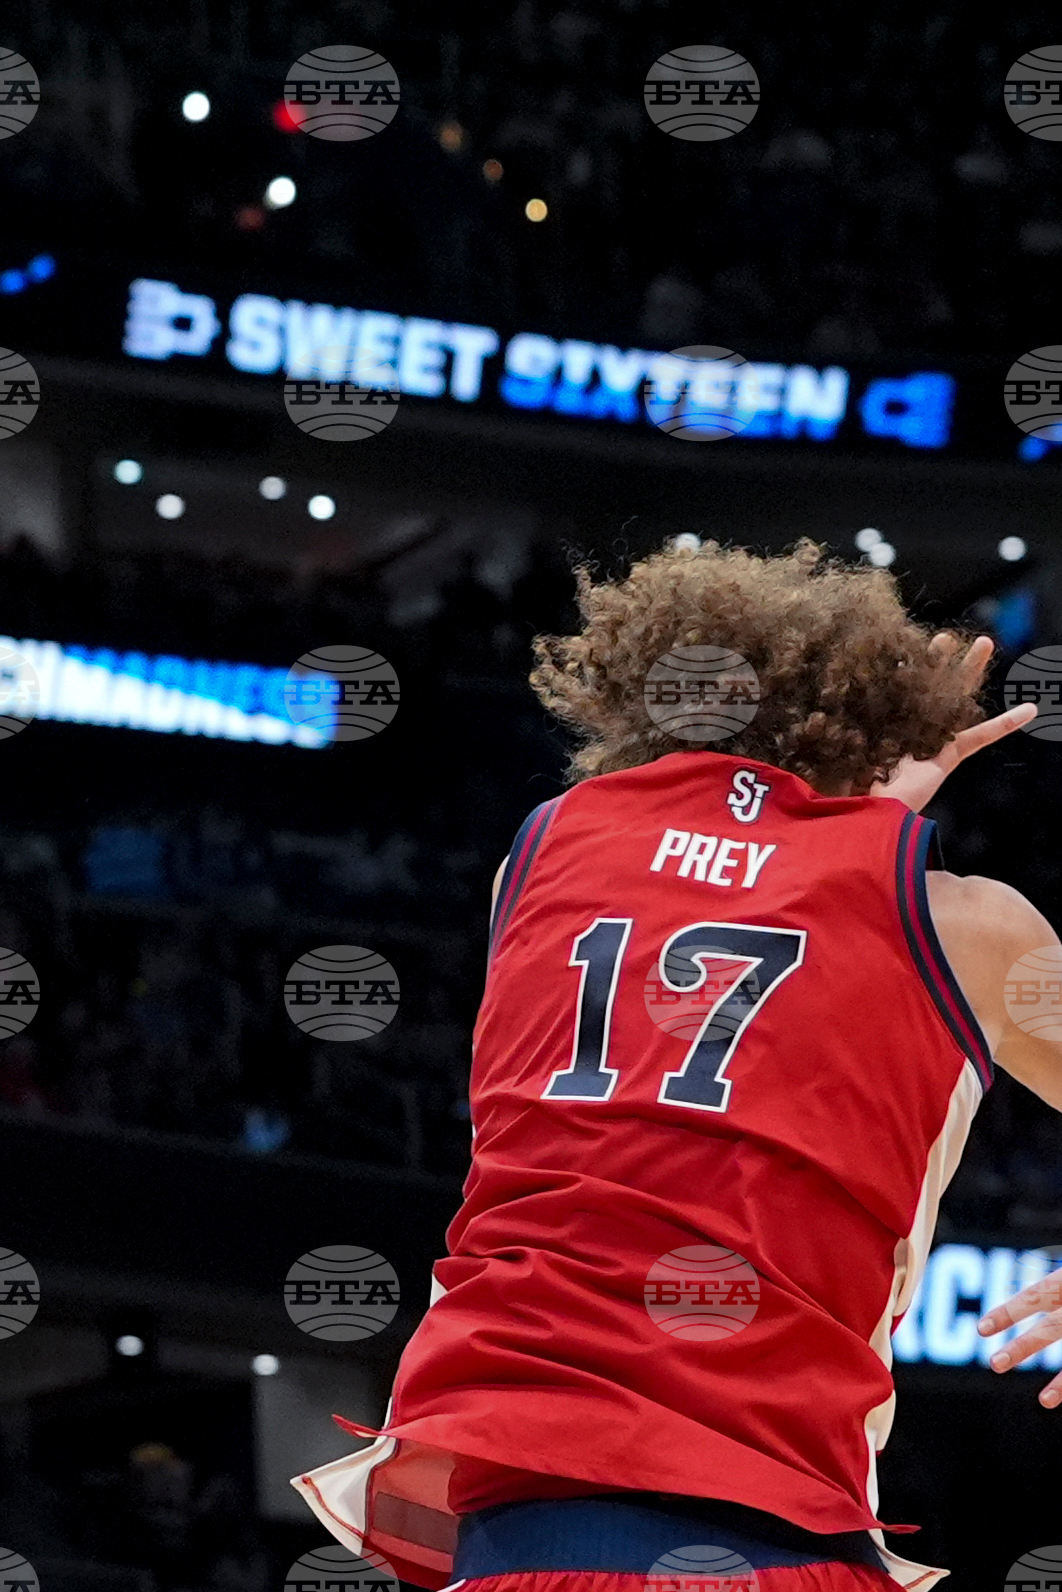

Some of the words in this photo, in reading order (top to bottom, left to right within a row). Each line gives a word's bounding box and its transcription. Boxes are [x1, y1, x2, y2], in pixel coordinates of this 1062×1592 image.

[226, 294, 499, 401] SWEET
[500, 333, 849, 440] SIXTEEN
[650, 828, 777, 889] PREY
[541, 917, 808, 1113] 17
